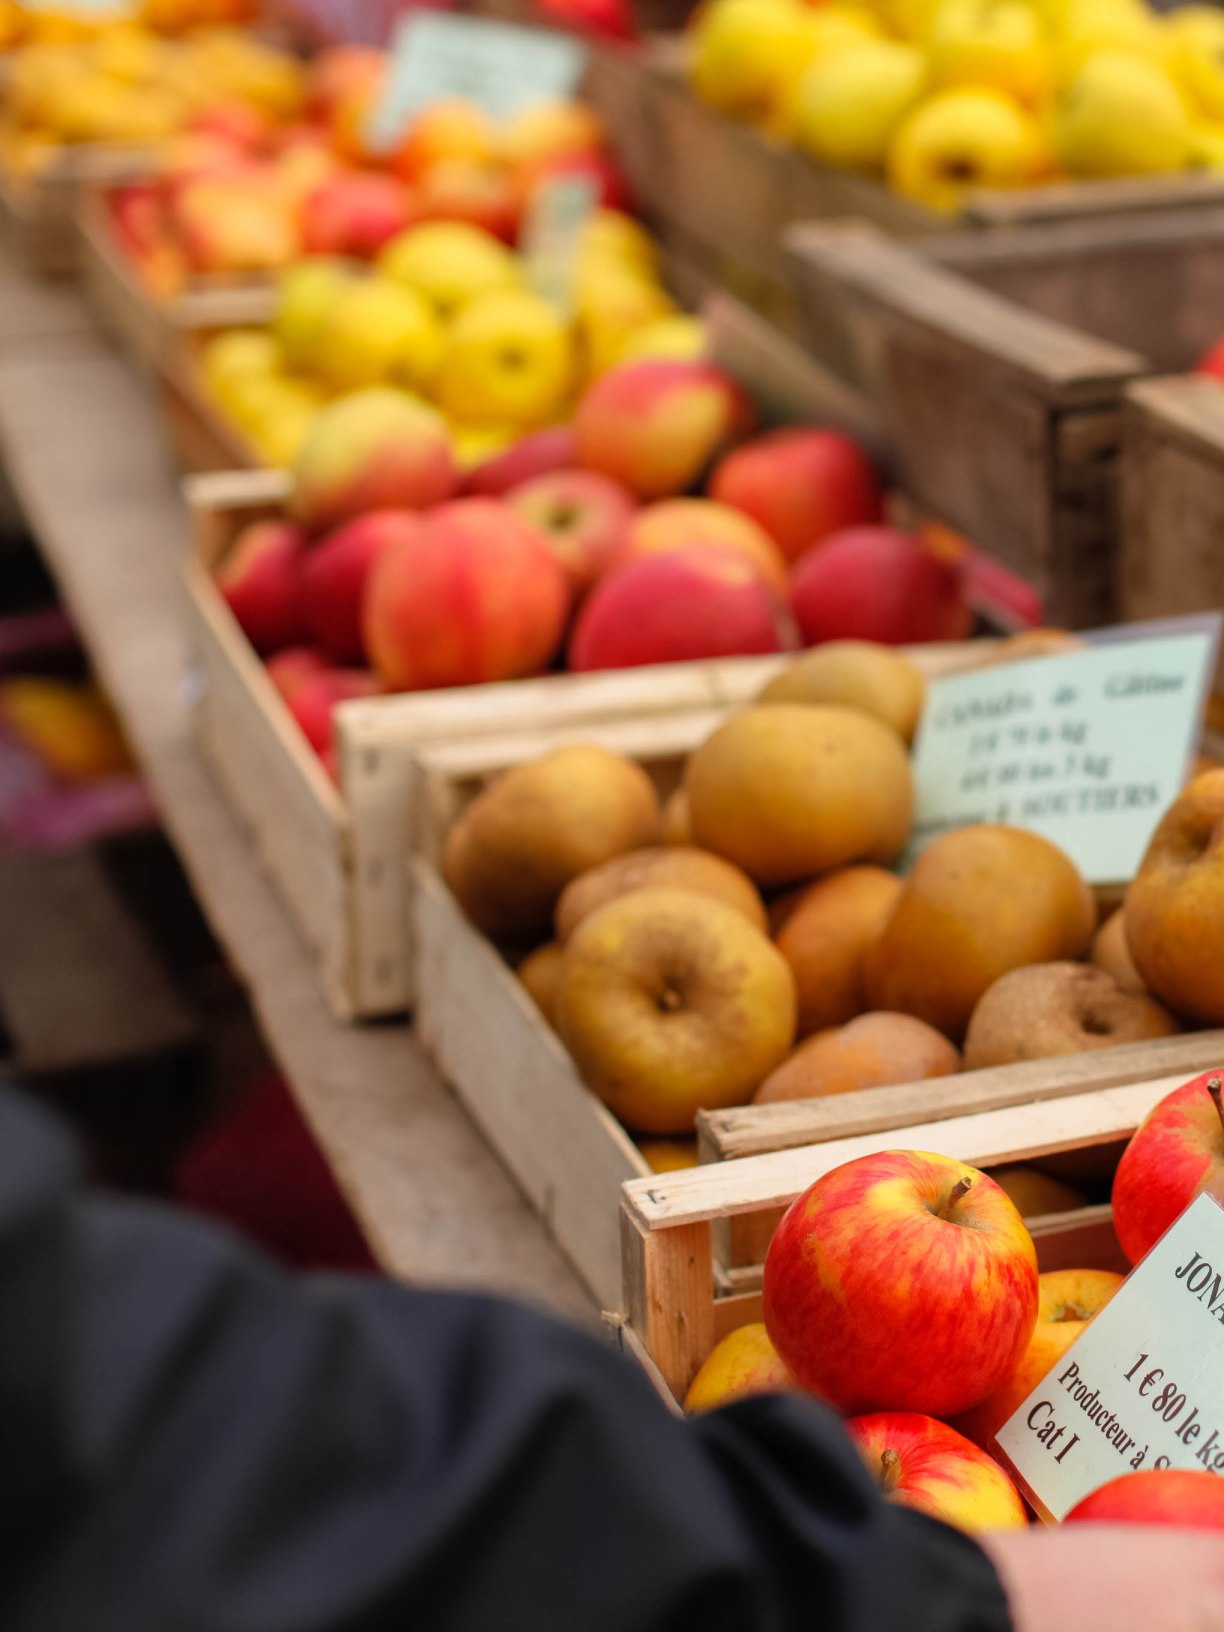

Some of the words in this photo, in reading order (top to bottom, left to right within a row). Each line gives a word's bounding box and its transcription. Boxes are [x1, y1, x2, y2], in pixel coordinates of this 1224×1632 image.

[1026, 1400, 1065, 1450] Cat
[1054, 1433, 1080, 1464] I
[1058, 1361, 1136, 1455] Producteur
[1129, 1445, 1149, 1470] à
[1174, 1406, 1201, 1445] le
